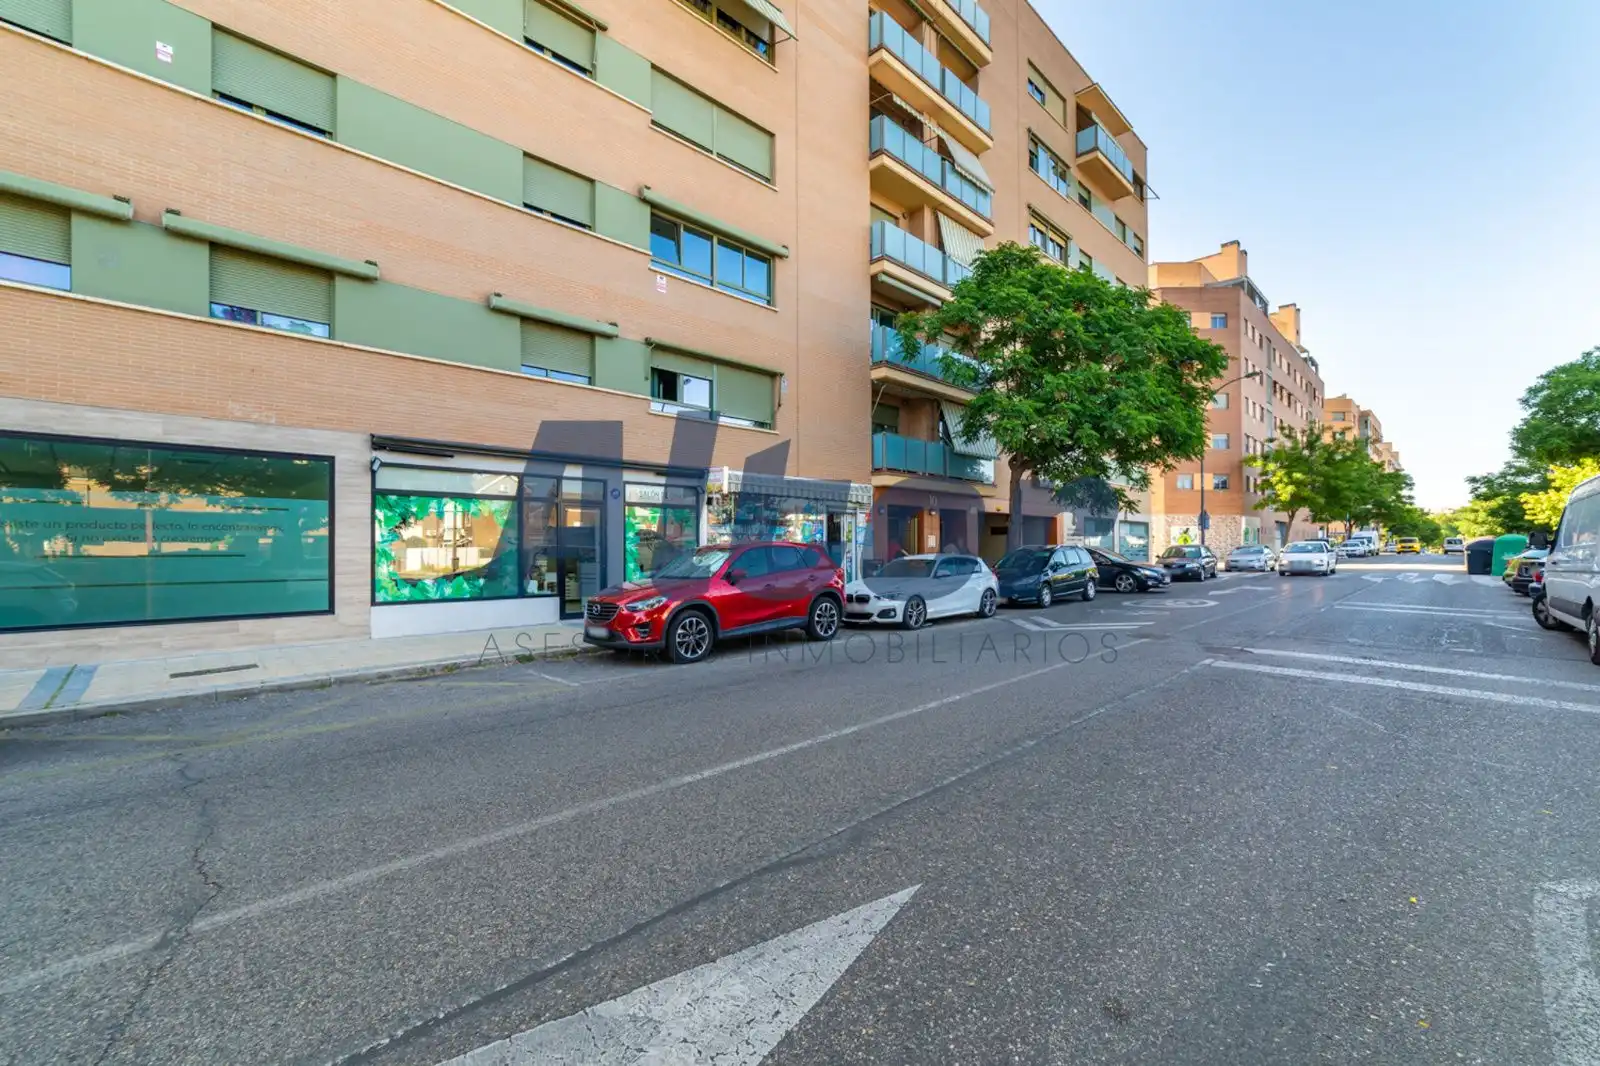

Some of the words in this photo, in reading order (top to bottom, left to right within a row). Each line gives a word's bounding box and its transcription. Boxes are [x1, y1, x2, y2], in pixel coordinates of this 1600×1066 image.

[43, 521, 61, 530] un
[65, 519, 127, 530] producto
[131, 520, 184, 532] pefecto,
